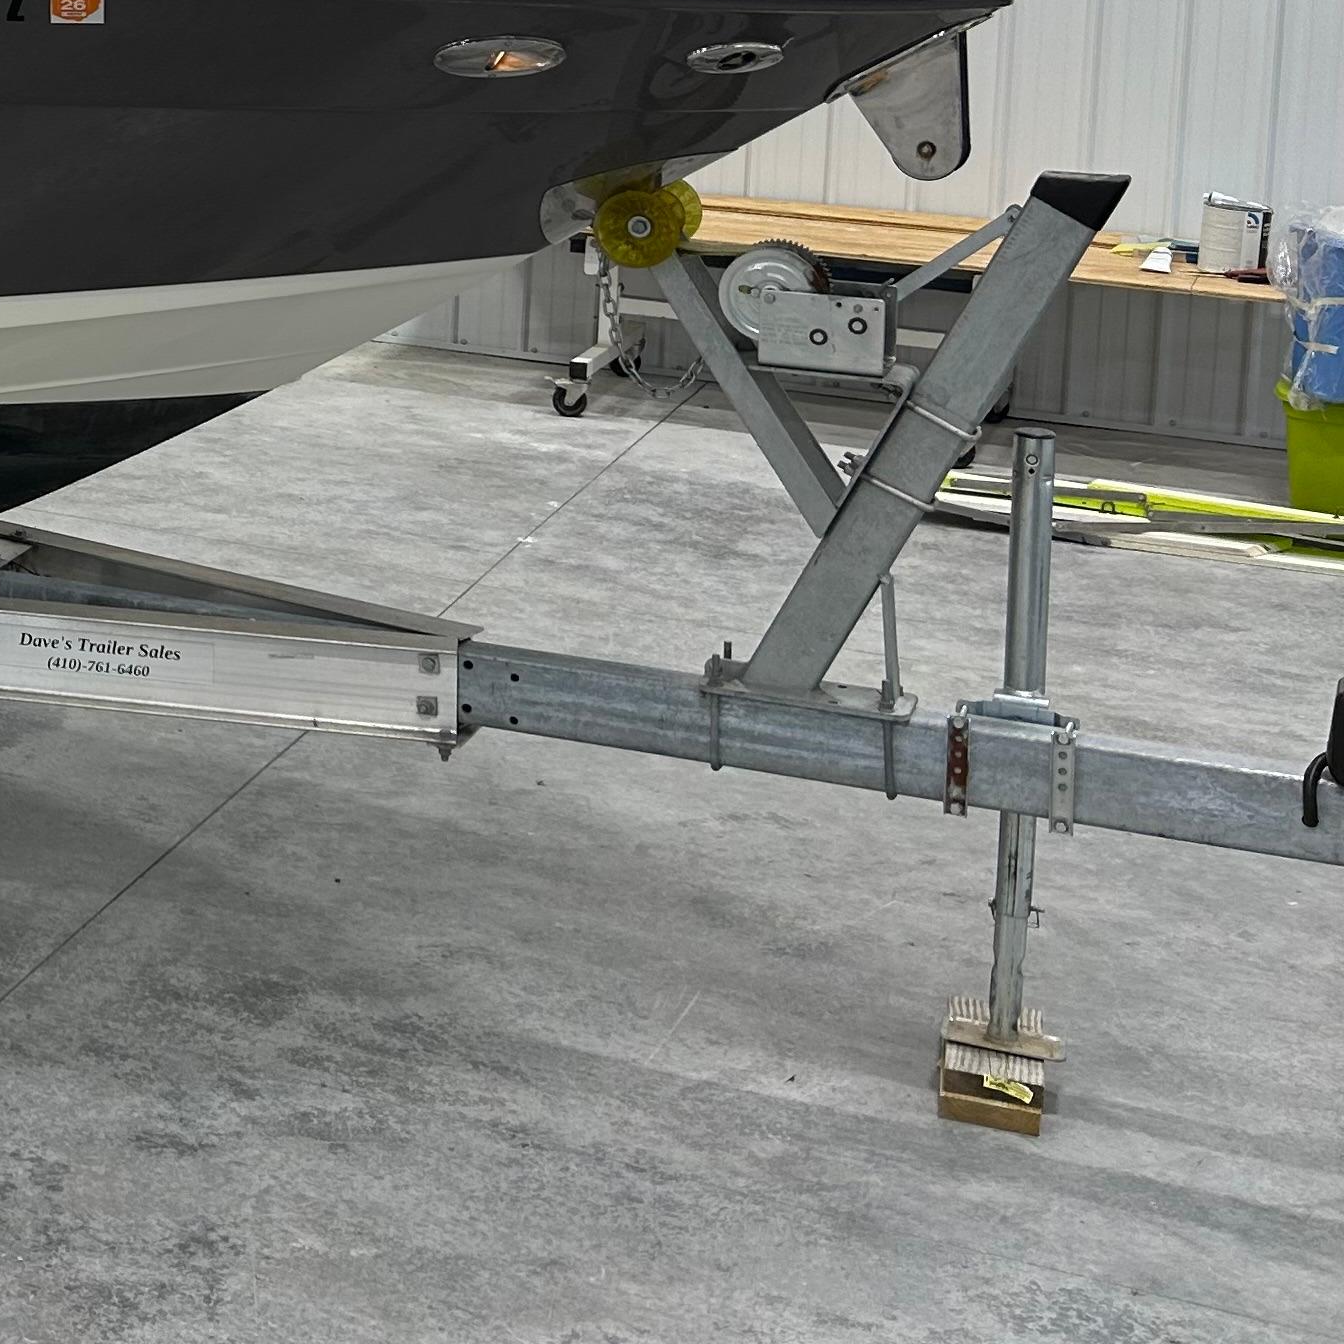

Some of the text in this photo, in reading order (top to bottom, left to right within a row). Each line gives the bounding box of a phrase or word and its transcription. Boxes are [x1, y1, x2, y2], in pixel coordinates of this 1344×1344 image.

[60, 0, 87, 11] 26
[19, 632, 181, 661] Dave's Trailer Sales
[47, 656, 150, 677] (410)-761-6460
